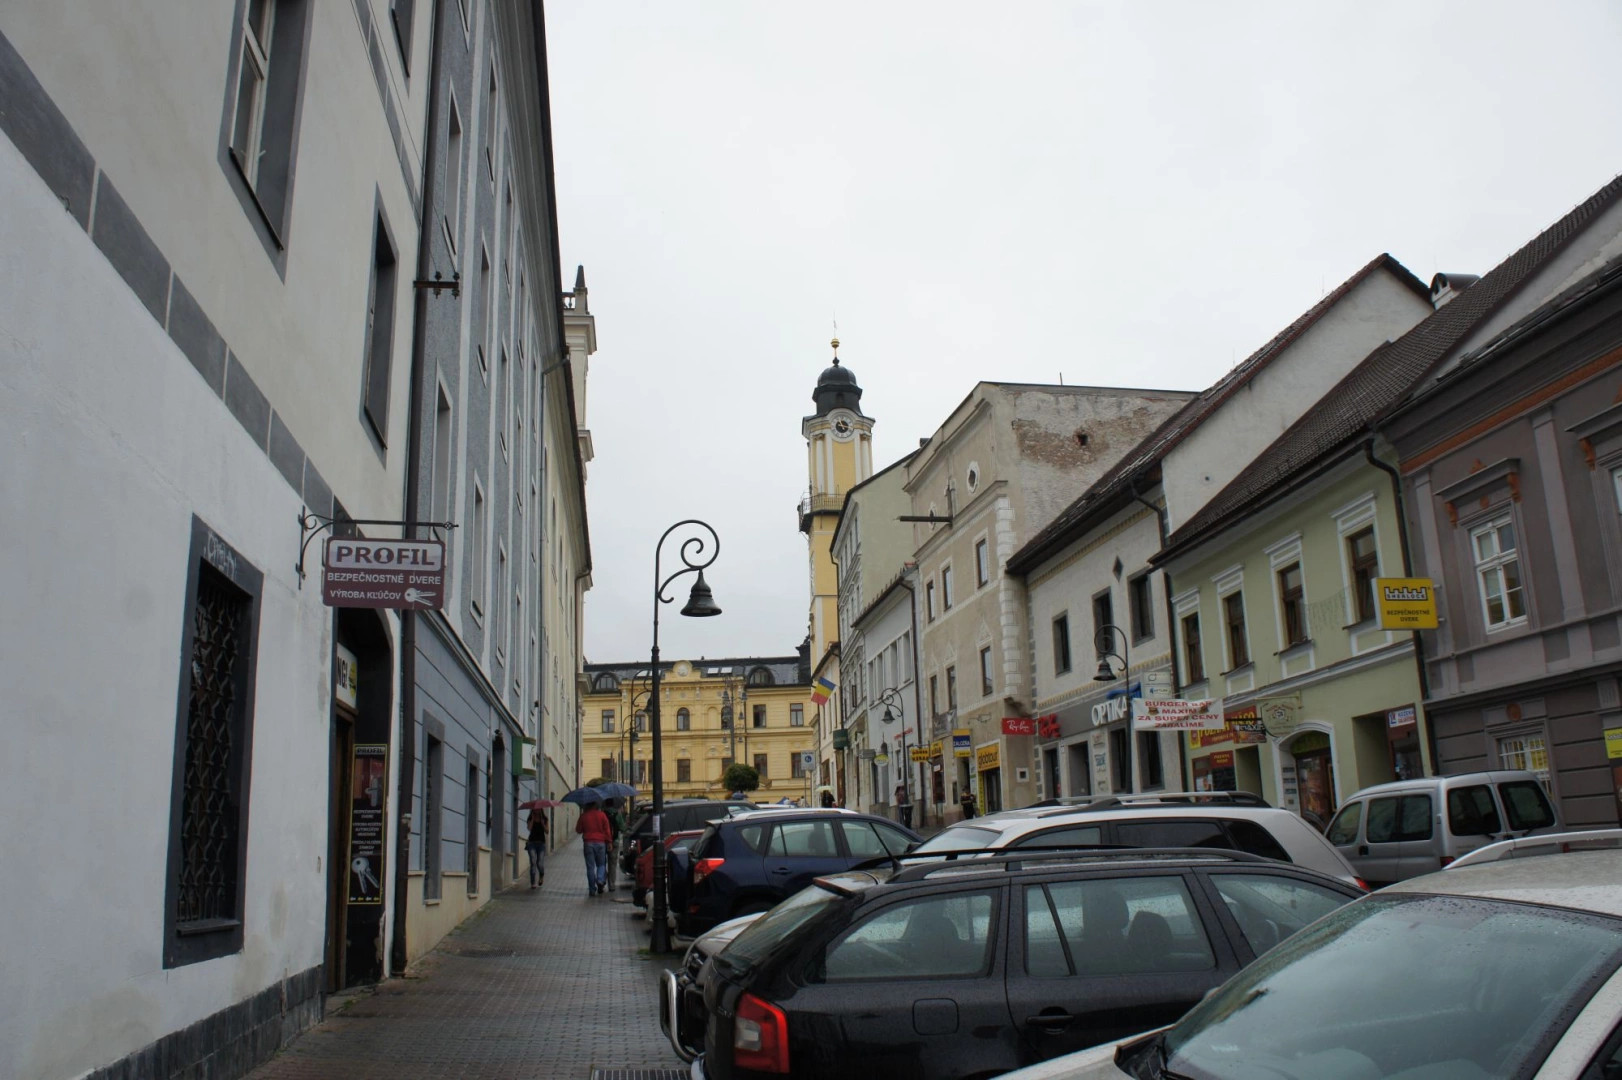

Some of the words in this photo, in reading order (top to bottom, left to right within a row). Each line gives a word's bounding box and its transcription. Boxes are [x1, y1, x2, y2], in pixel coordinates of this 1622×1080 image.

[336, 546, 435, 566] PROFIL
[327, 572, 404, 584] BEZPEČNOSTNÉ
[409, 575, 441, 585] DVERE
[330, 589, 367, 599] VÝROBA
[1091, 696, 1128, 727] OPTIKA
